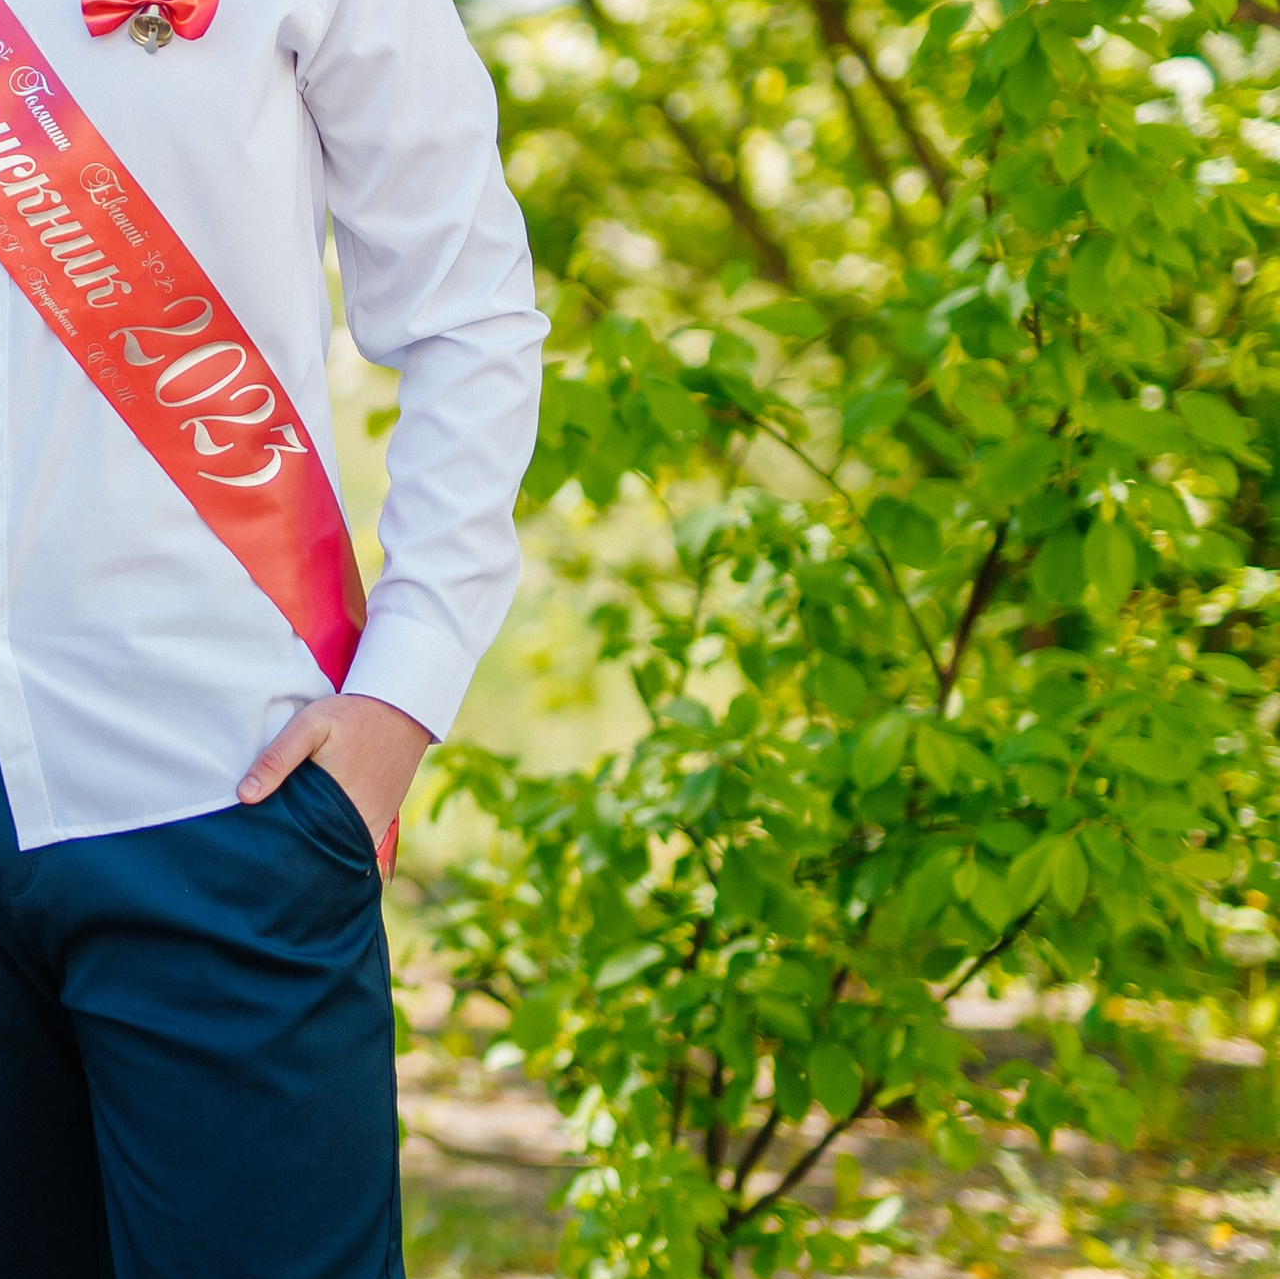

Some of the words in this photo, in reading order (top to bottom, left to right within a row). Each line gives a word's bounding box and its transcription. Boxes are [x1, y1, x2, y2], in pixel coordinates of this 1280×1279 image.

[9, 65, 72, 153] Голяшин
[79, 162, 152, 248] Евгений
[108, 294, 309, 488] 2023
